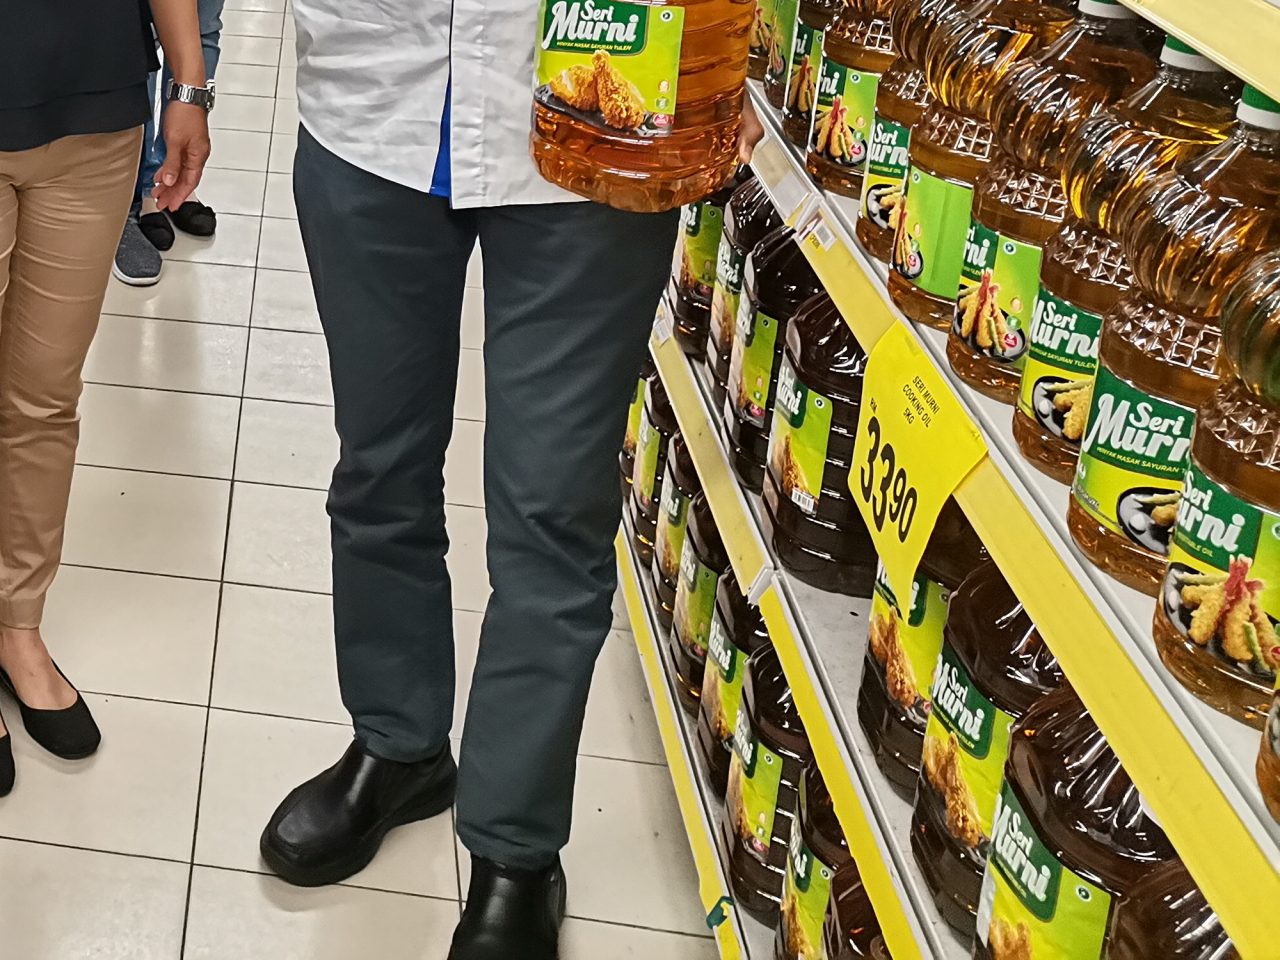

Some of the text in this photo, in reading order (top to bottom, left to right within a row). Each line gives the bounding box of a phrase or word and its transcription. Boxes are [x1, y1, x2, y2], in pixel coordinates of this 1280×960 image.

[541, 0, 639, 50] Murni
[580, 0, 614, 21] Seri
[1043, 301, 1078, 331] Seri
[902, 384, 934, 428] COOKING OIL
[913, 376, 940, 415] SERI MURNI
[903, 408, 915, 425] 5KG
[1129, 402, 1185, 435] Seri
[1117, 453, 1140, 466] MASAK
[1141, 460, 1180, 473] SAYURAN
[1184, 470, 1213, 511] Seri
[948, 669, 969, 701] Seri
